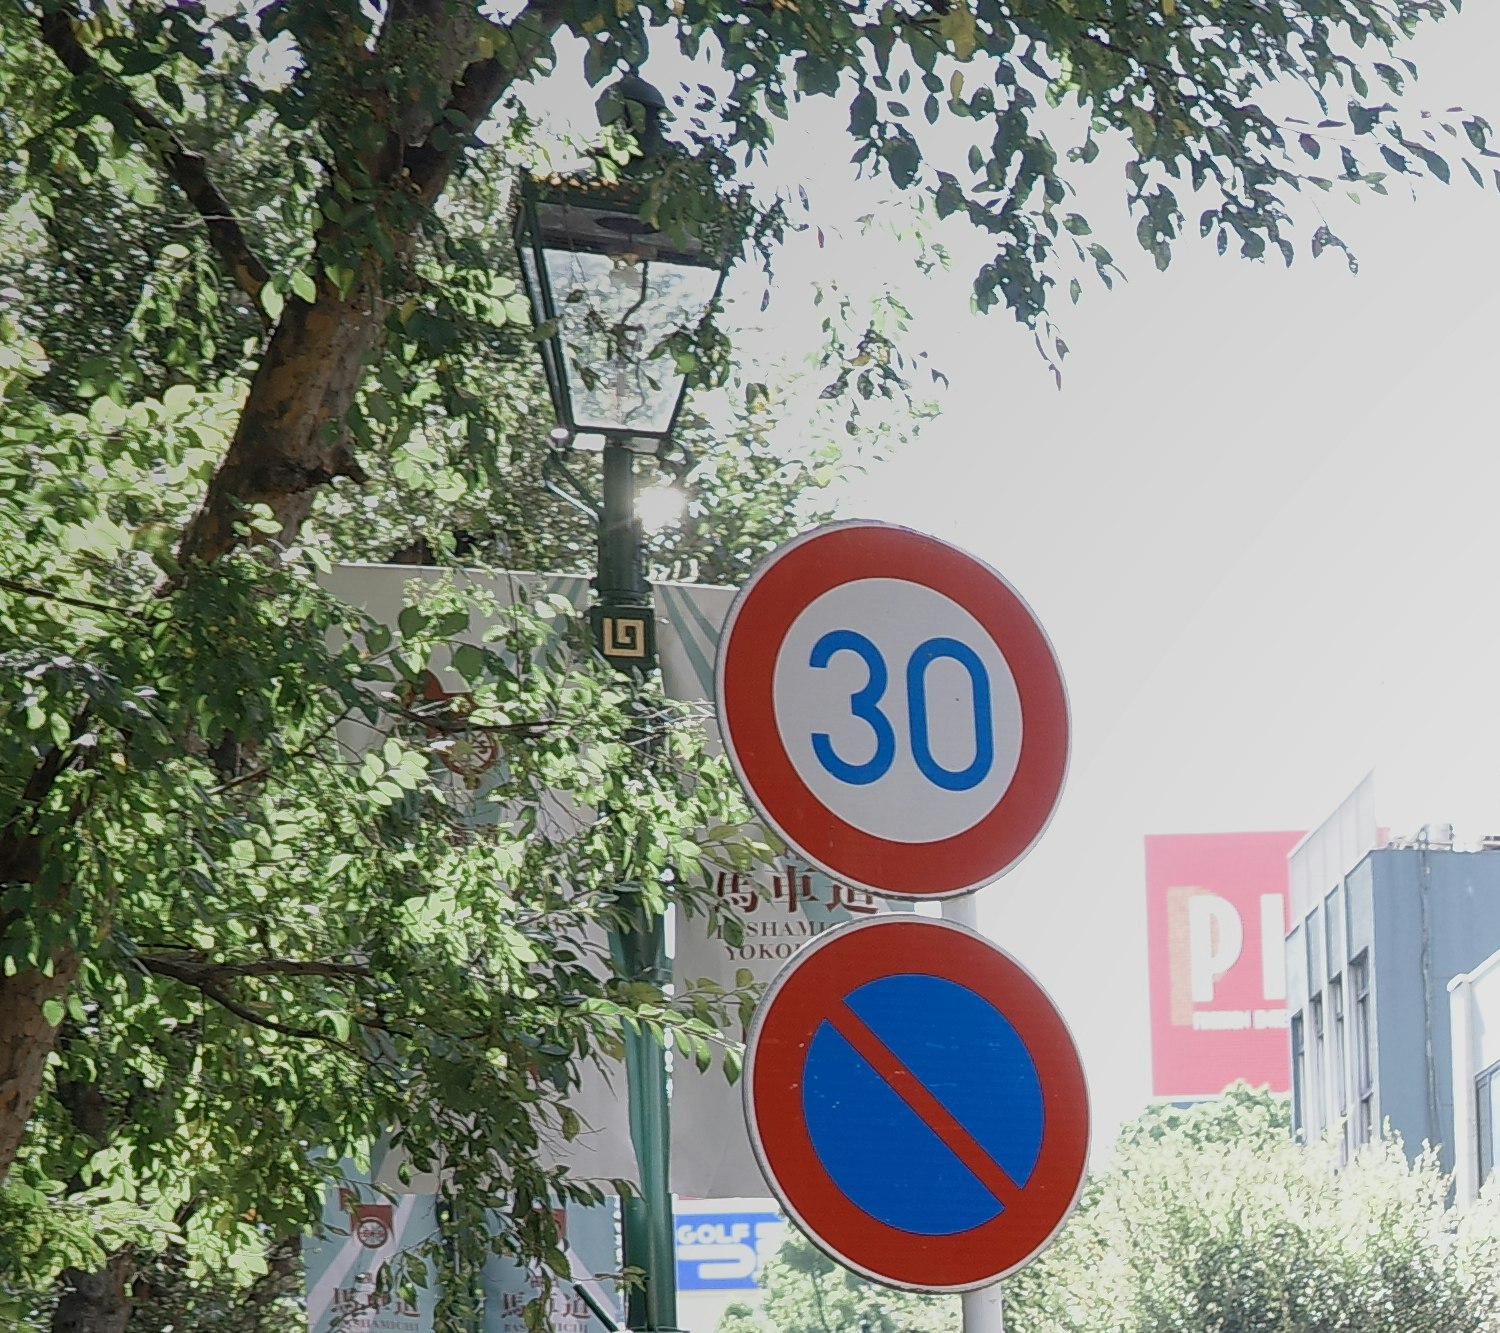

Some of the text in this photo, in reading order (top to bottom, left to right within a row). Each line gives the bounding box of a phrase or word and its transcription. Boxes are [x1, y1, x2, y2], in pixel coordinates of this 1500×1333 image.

[809, 628, 994, 791] 30
[725, 943, 802, 961] YOKO
[677, 1223, 749, 1244] GOLF
